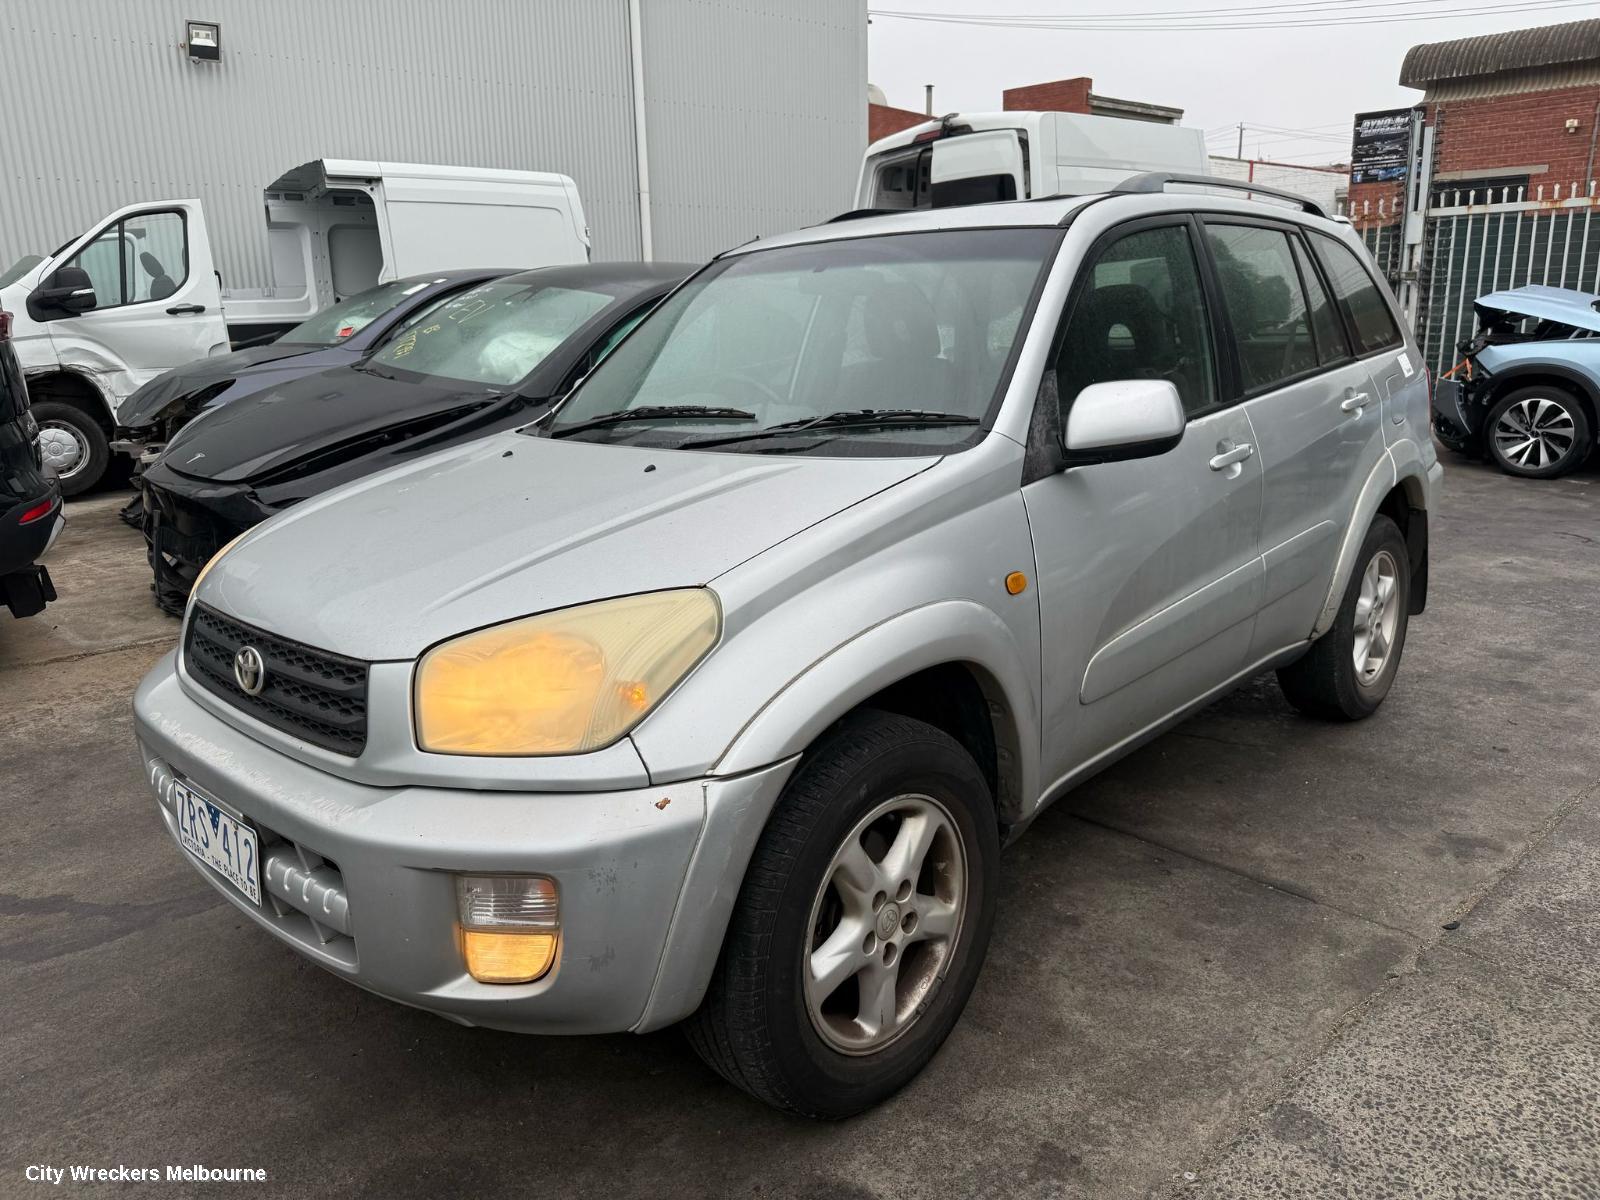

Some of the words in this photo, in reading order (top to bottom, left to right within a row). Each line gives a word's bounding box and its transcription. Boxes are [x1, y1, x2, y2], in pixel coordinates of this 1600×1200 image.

[178, 791, 209, 848] ZRS
[223, 823, 255, 886] 412
[183, 837, 206, 859] VICTORIA
[212, 855, 222, 871] THE
[223, 866, 239, 884] PLACE
[240, 872, 248, 891] TO
[249, 885, 257, 900] BE
